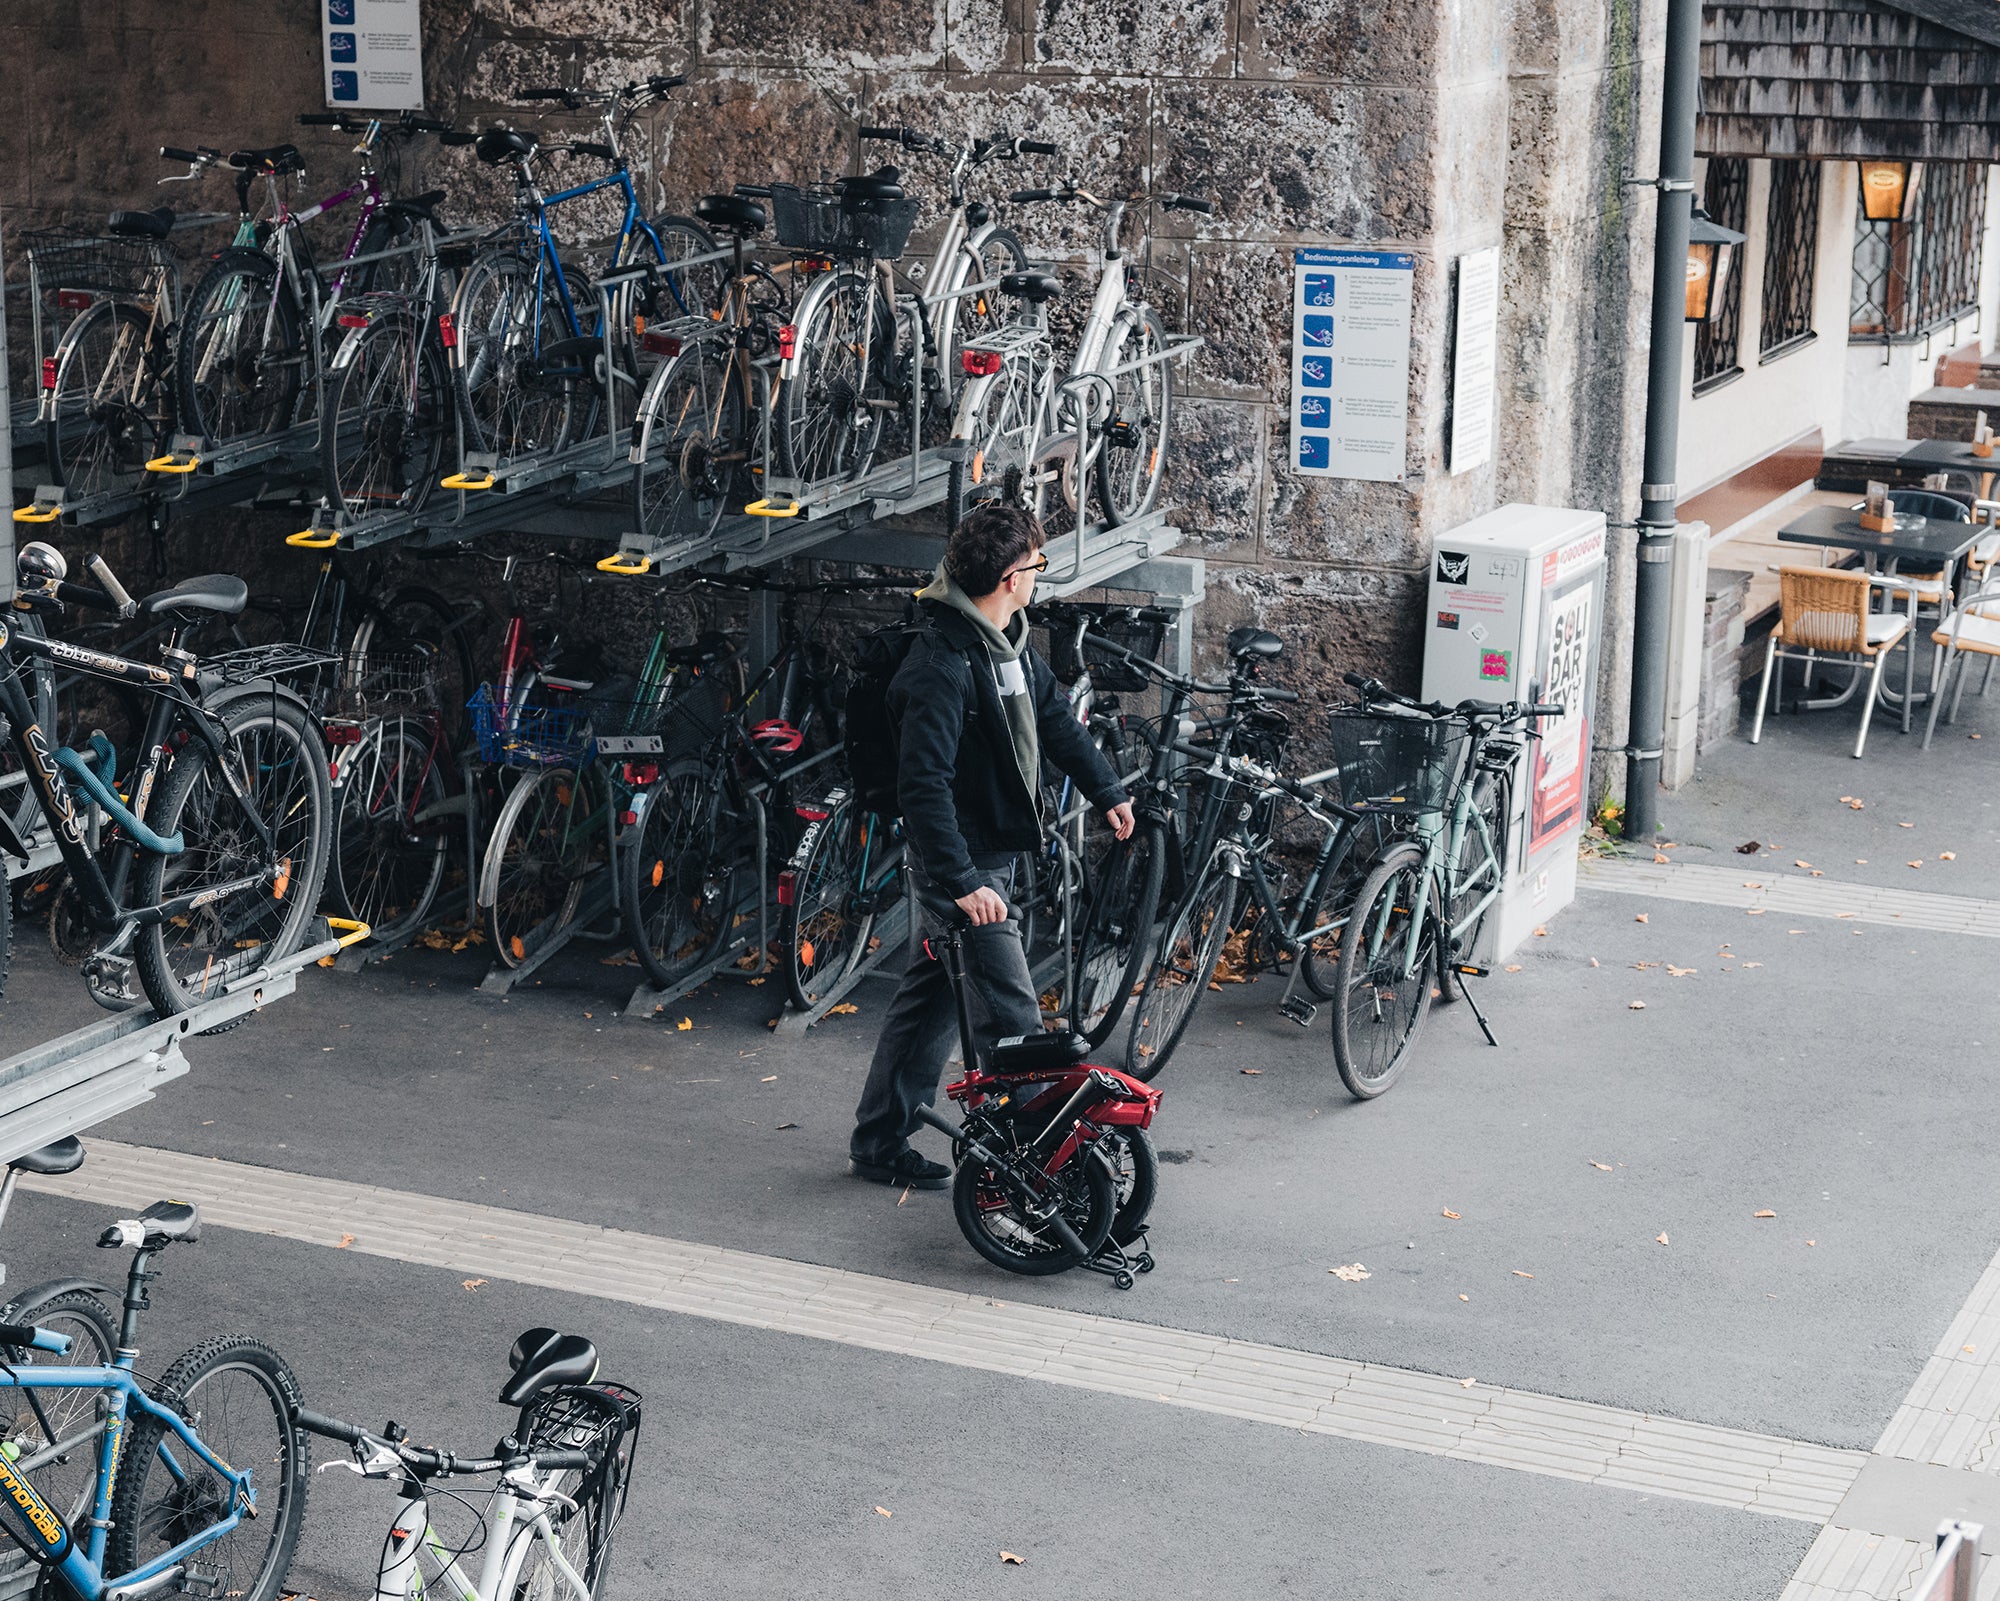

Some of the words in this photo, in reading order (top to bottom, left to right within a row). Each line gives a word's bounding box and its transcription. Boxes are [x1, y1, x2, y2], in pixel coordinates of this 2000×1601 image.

[1304, 253, 1380, 265] Bedienungsanleitung
[1550, 643, 1582, 692] DAR
[275, 1370, 306, 1477] SCHLBE
[106, 1433, 121, 1500] cannondale
[0, 1461, 61, 1545] annondale
